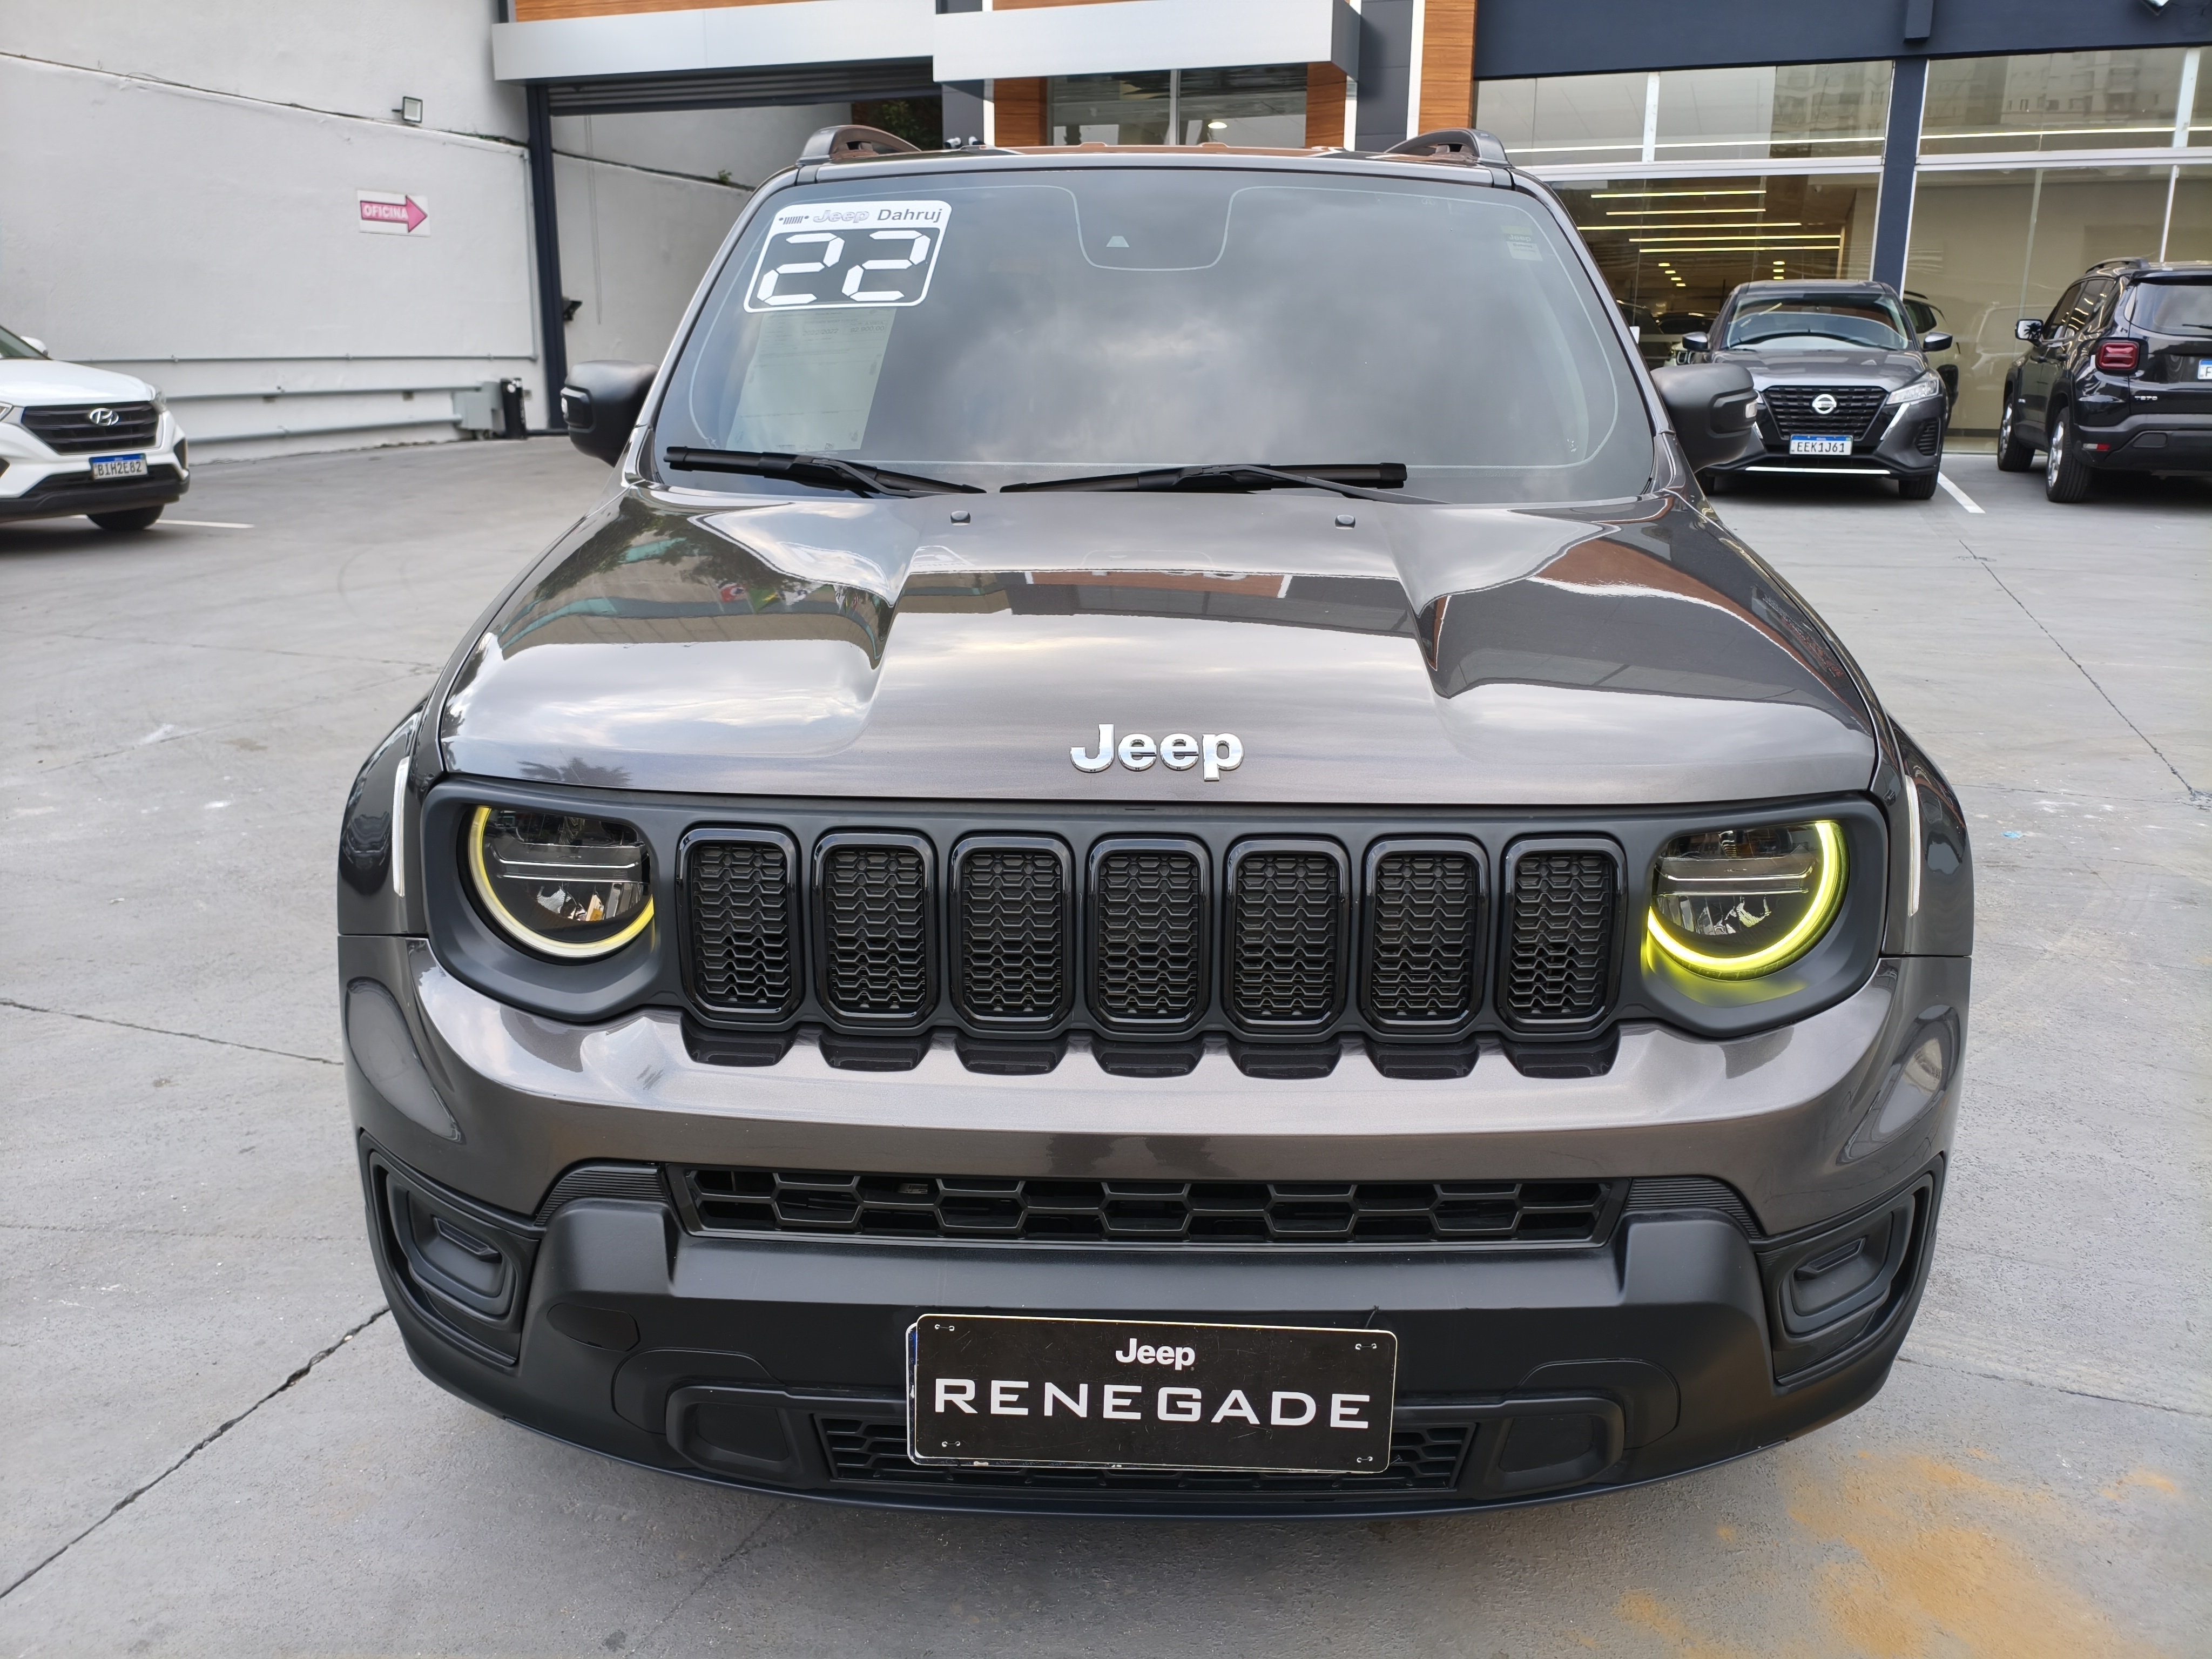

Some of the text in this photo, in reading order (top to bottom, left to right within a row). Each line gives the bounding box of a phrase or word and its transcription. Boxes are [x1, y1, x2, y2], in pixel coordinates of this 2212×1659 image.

[364, 205, 409, 219] OFICINA
[813, 208, 943, 224] Jeep Dahruj
[757, 230, 931, 306] 22
[1797, 442, 1844, 453] EEK1J61
[1070, 723, 1244, 782] Jeep
[1115, 1338, 1195, 1371] Jeep
[934, 1378, 1370, 1428] RENEGADE
